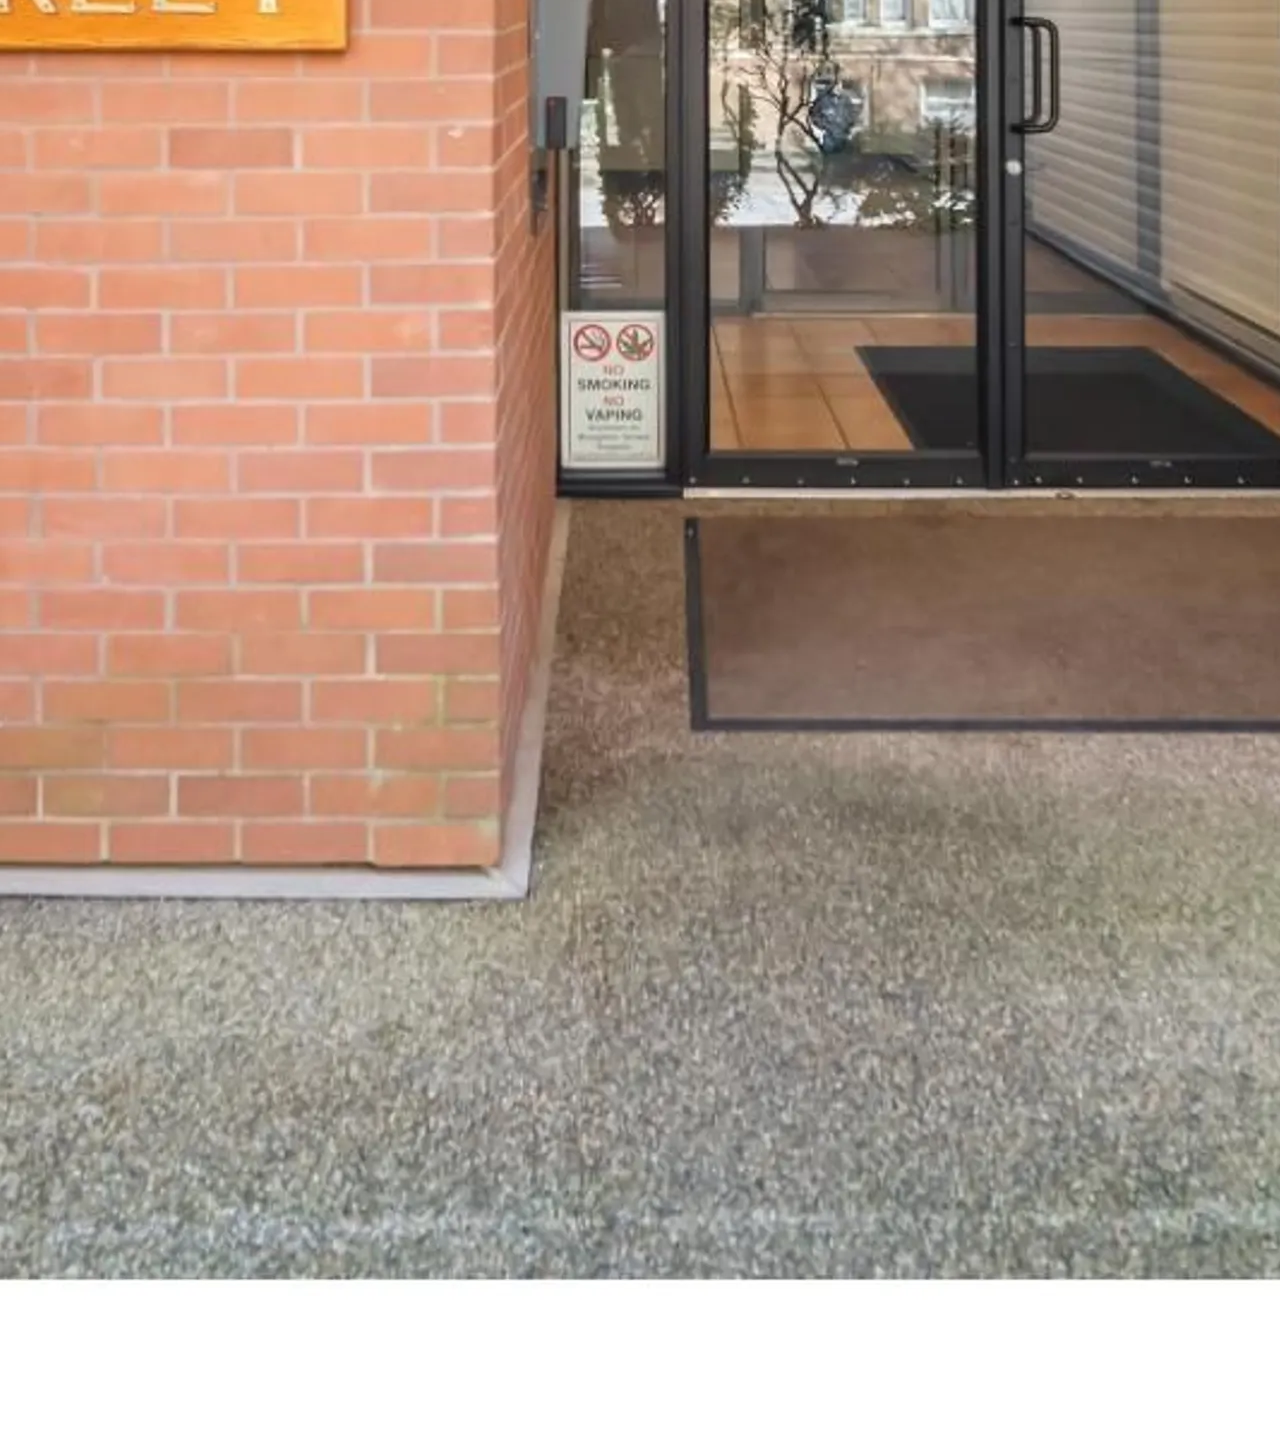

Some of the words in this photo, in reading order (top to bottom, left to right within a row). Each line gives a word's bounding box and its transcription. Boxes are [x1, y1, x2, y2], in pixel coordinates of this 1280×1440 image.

[602, 364, 626, 377] NO
[577, 378, 651, 392] SMOKING
[602, 395, 625, 407] NO
[586, 409, 644, 422] VAPING
